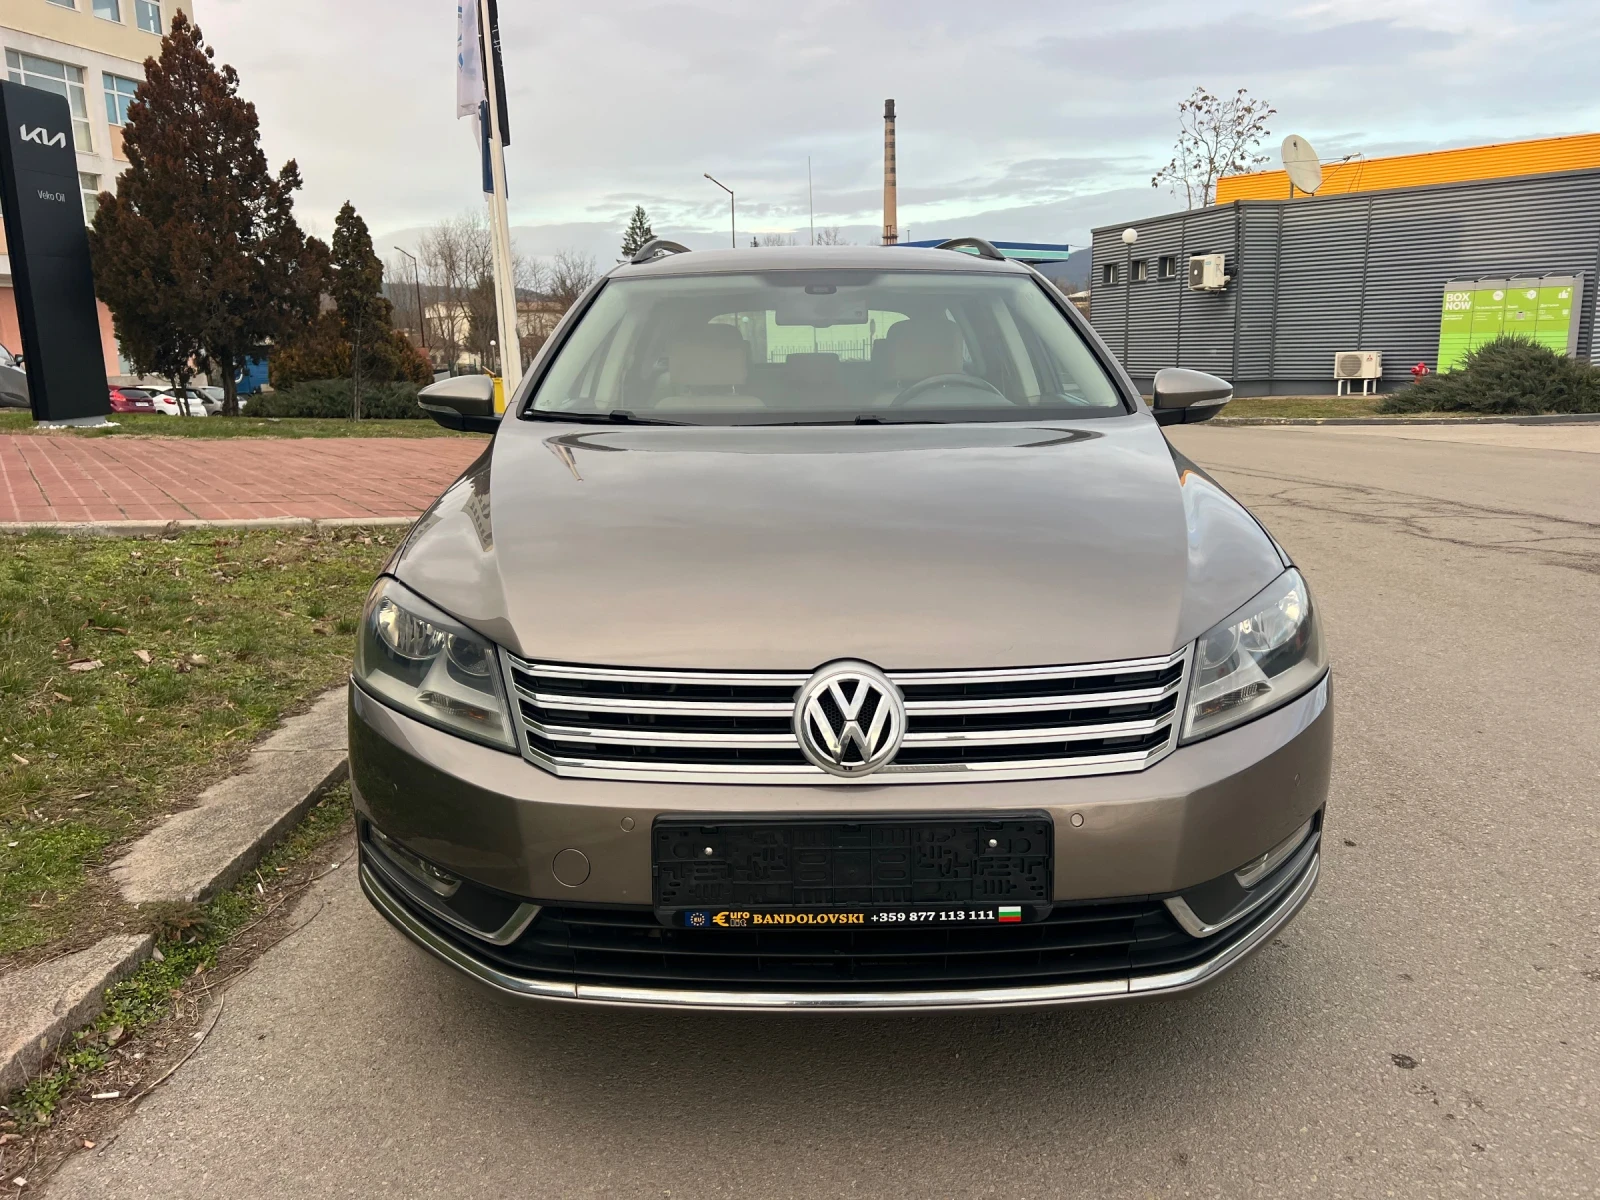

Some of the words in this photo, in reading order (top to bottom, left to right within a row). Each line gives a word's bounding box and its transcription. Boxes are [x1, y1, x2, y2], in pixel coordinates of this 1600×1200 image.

[37, 190, 55, 201] Veko
[55, 192, 66, 203] Oil
[1446, 292, 1470, 302] BOX
[1445, 301, 1472, 311] NOW
[752, 913, 865, 924] BANDOLOVSKI
[870, 912, 906, 922] +359
[909, 912, 936, 921] 877
[939, 911, 965, 921] 113
[968, 910, 995, 920] 111
